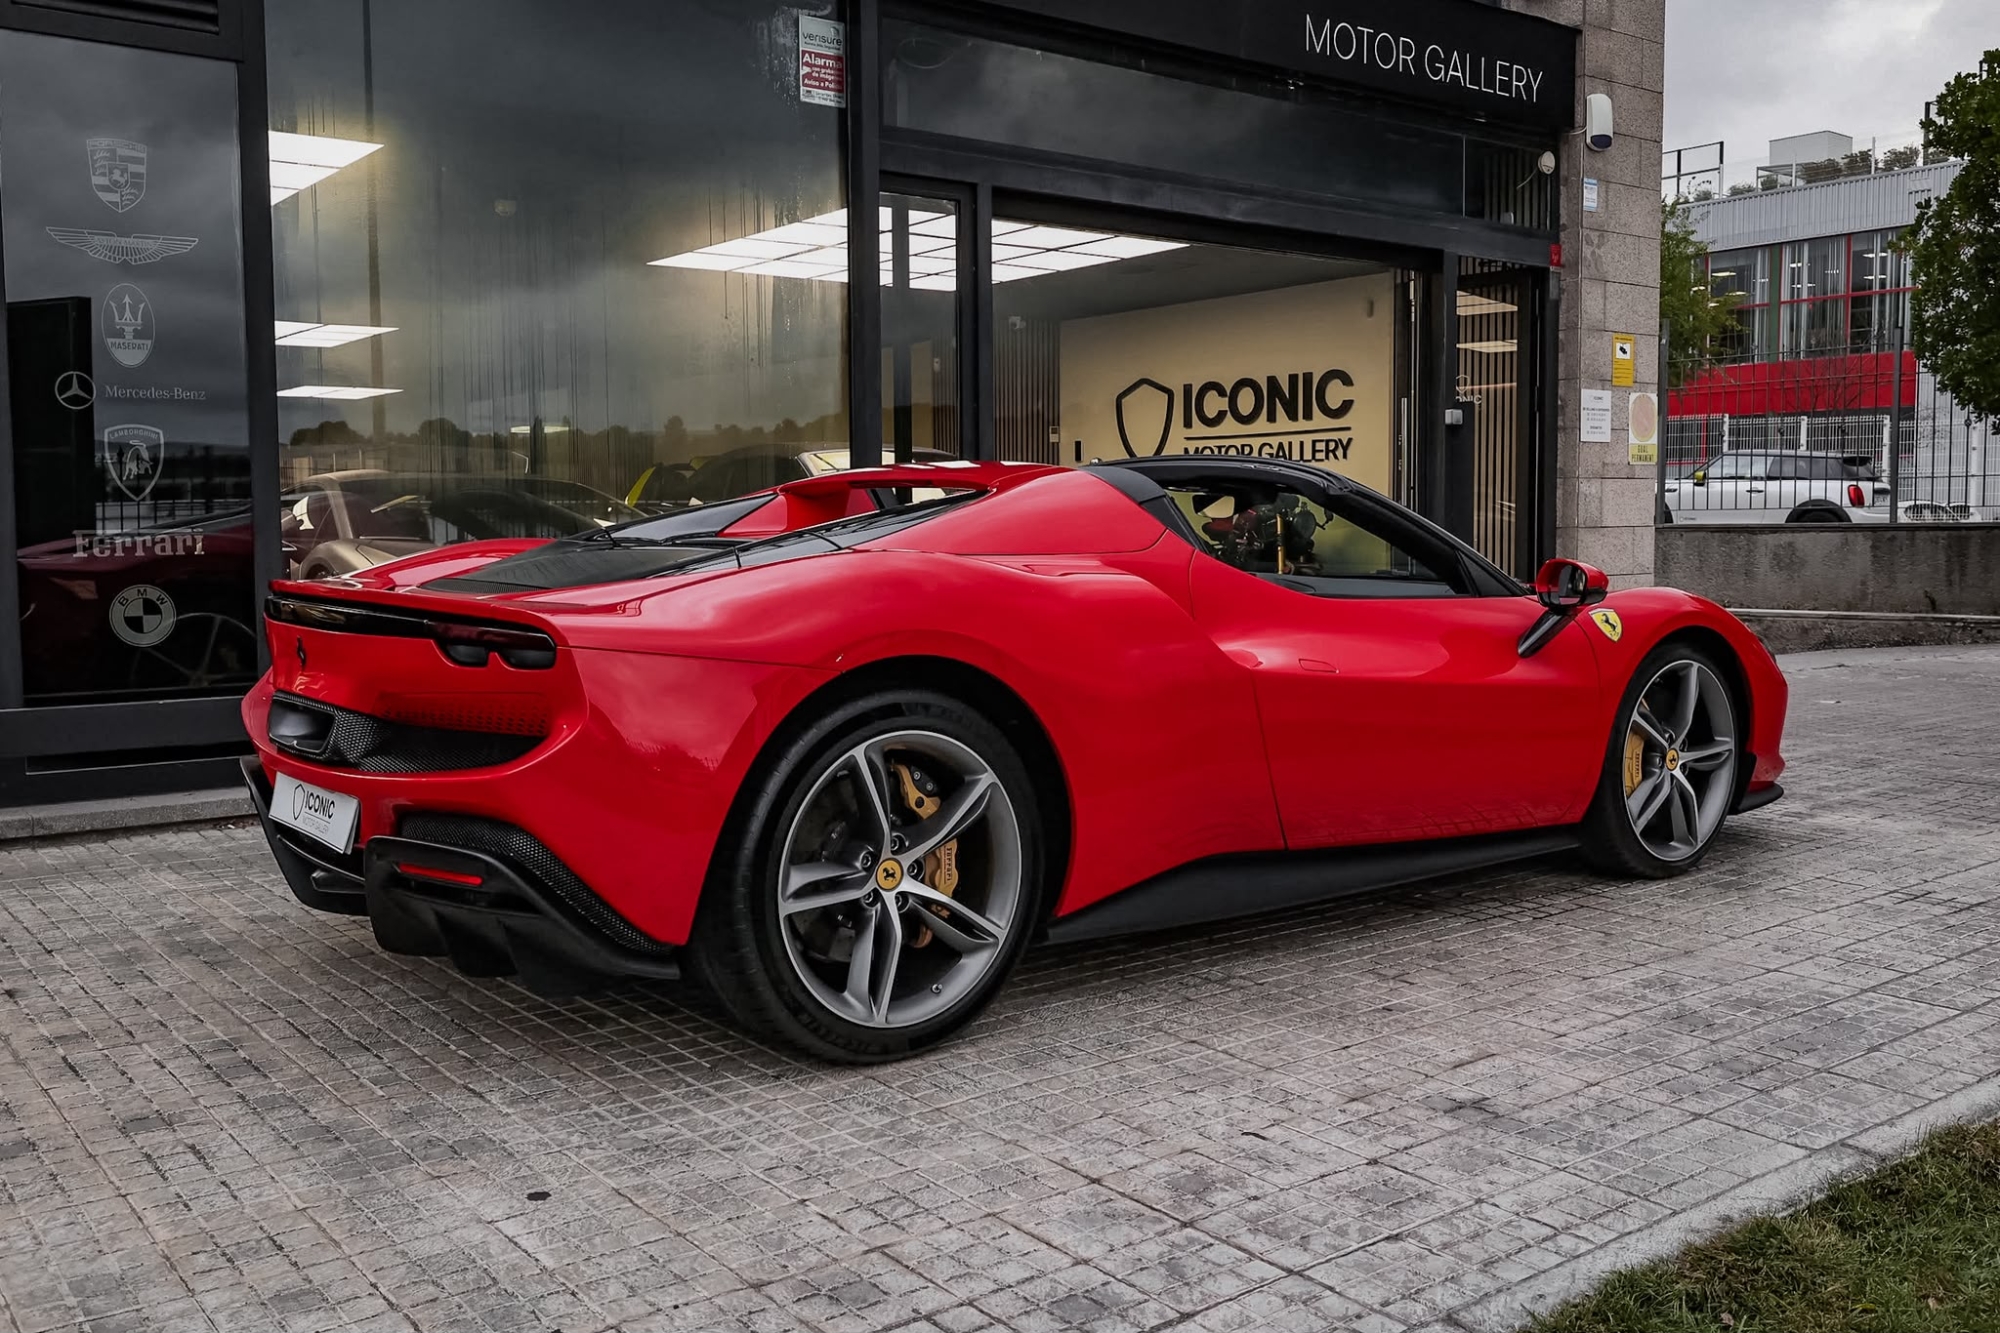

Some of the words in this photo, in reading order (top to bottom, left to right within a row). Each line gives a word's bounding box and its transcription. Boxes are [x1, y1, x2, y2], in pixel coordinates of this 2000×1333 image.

[802, 32, 842, 47] verisure
[803, 53, 842, 69] Alarma
[1305, 13, 1416, 76] MOTOR
[1424, 44, 1543, 103] GALLERY
[110, 341, 149, 351] MASERATI
[105, 385, 206, 400] Mercedes-Benz
[1183, 368, 1355, 430] ICONIC
[1257, 437, 1353, 463] GALLERY
[72, 527, 205, 558] Ferrari
[118, 588, 168, 607] BMW
[305, 791, 335, 819] ICONIC
